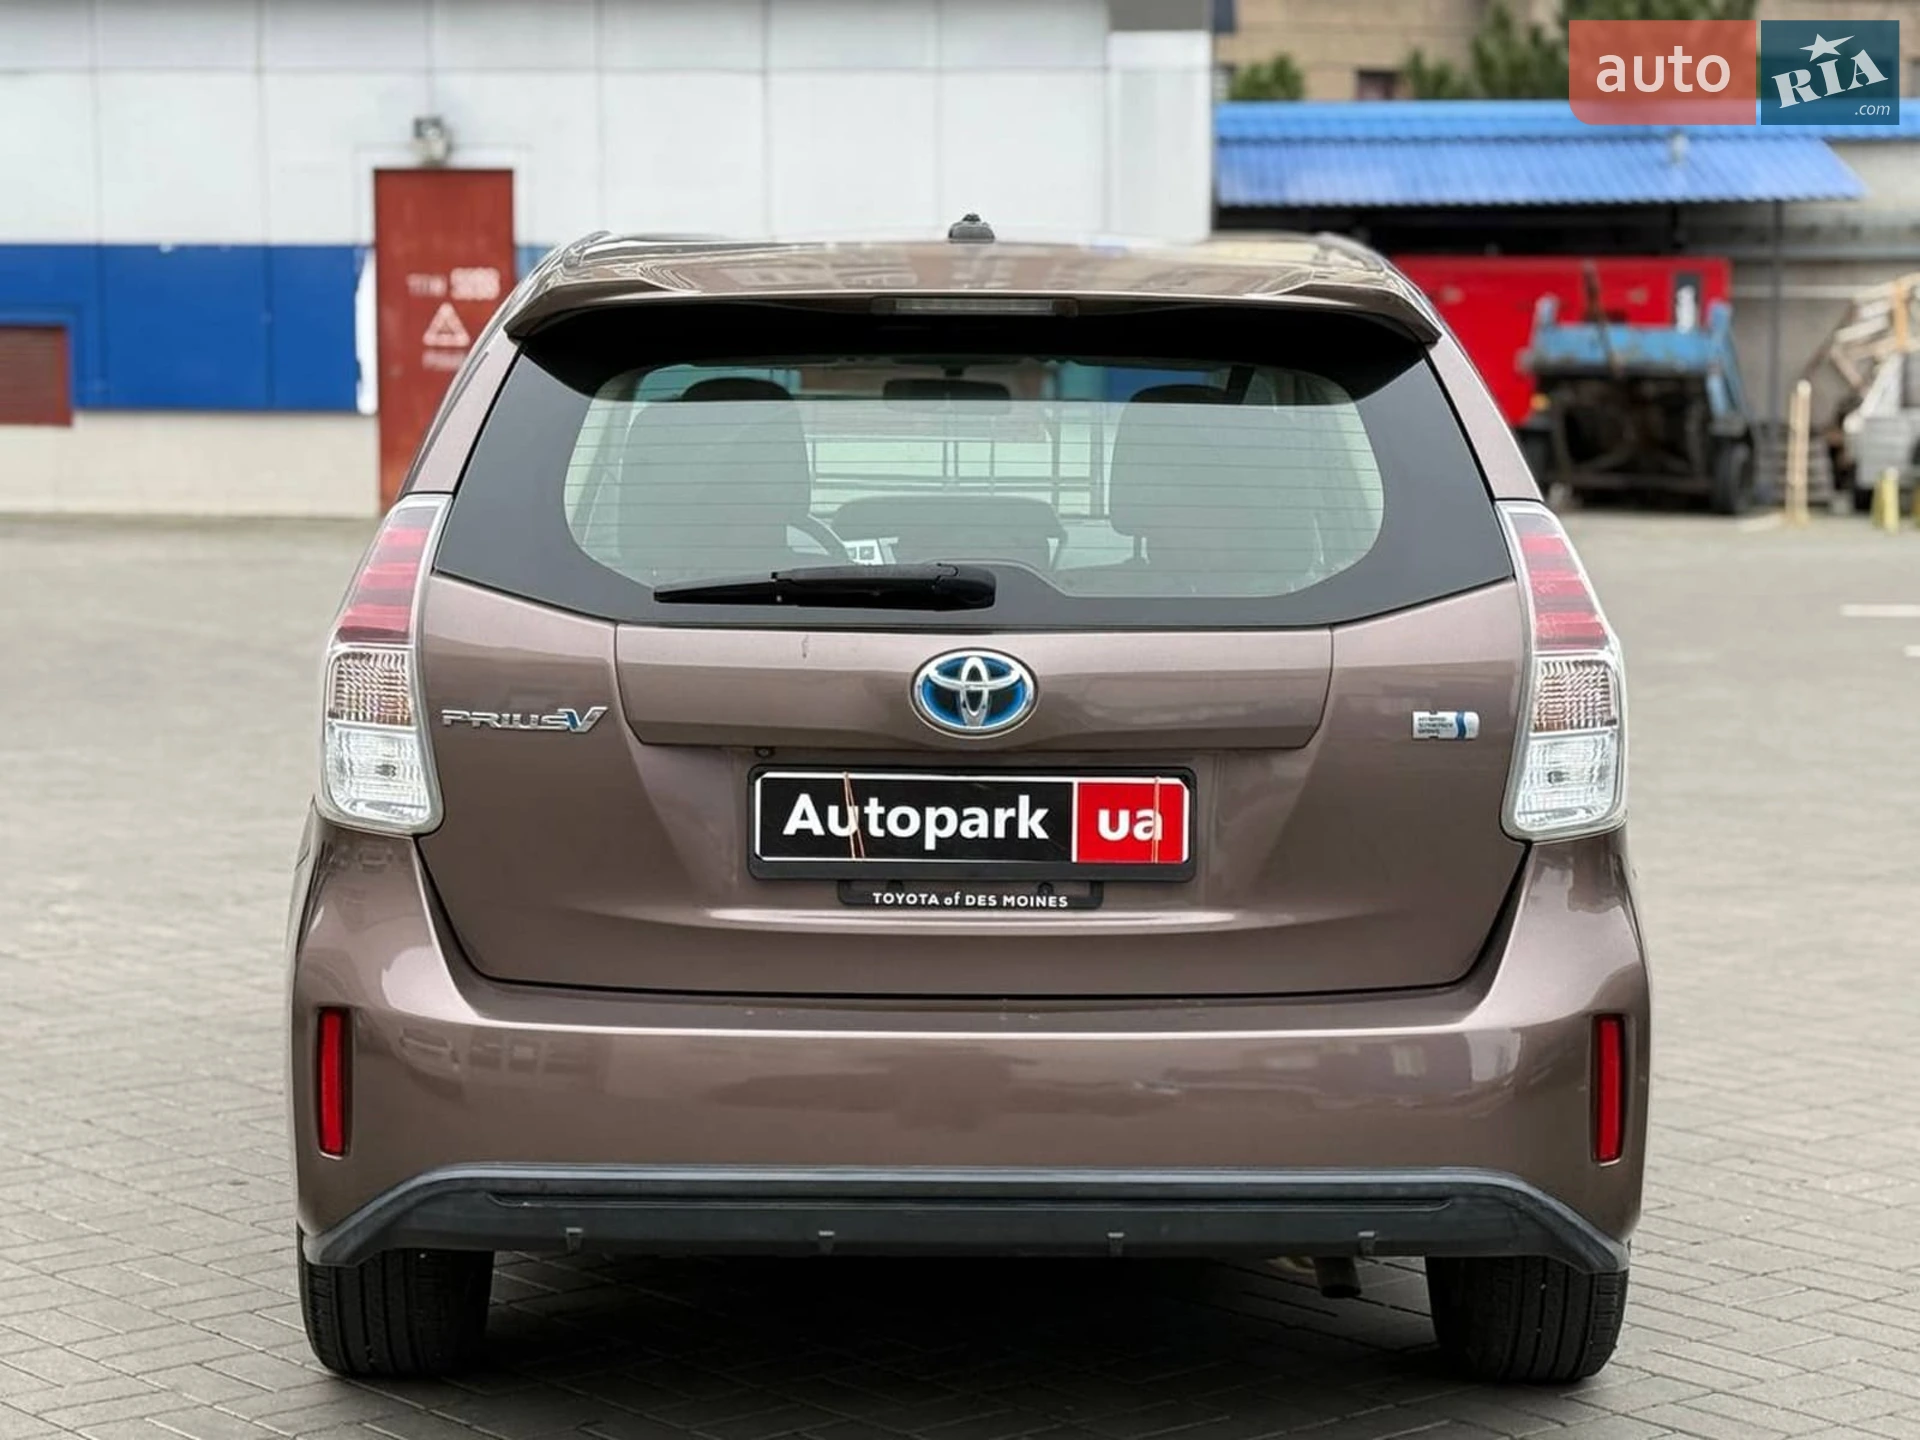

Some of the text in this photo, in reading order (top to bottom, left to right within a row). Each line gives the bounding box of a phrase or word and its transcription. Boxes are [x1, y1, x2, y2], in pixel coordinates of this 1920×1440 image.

[782, 793, 1163, 851] Autopark ua
[872, 891, 1069, 908] TOYOTA of DES MOINES
